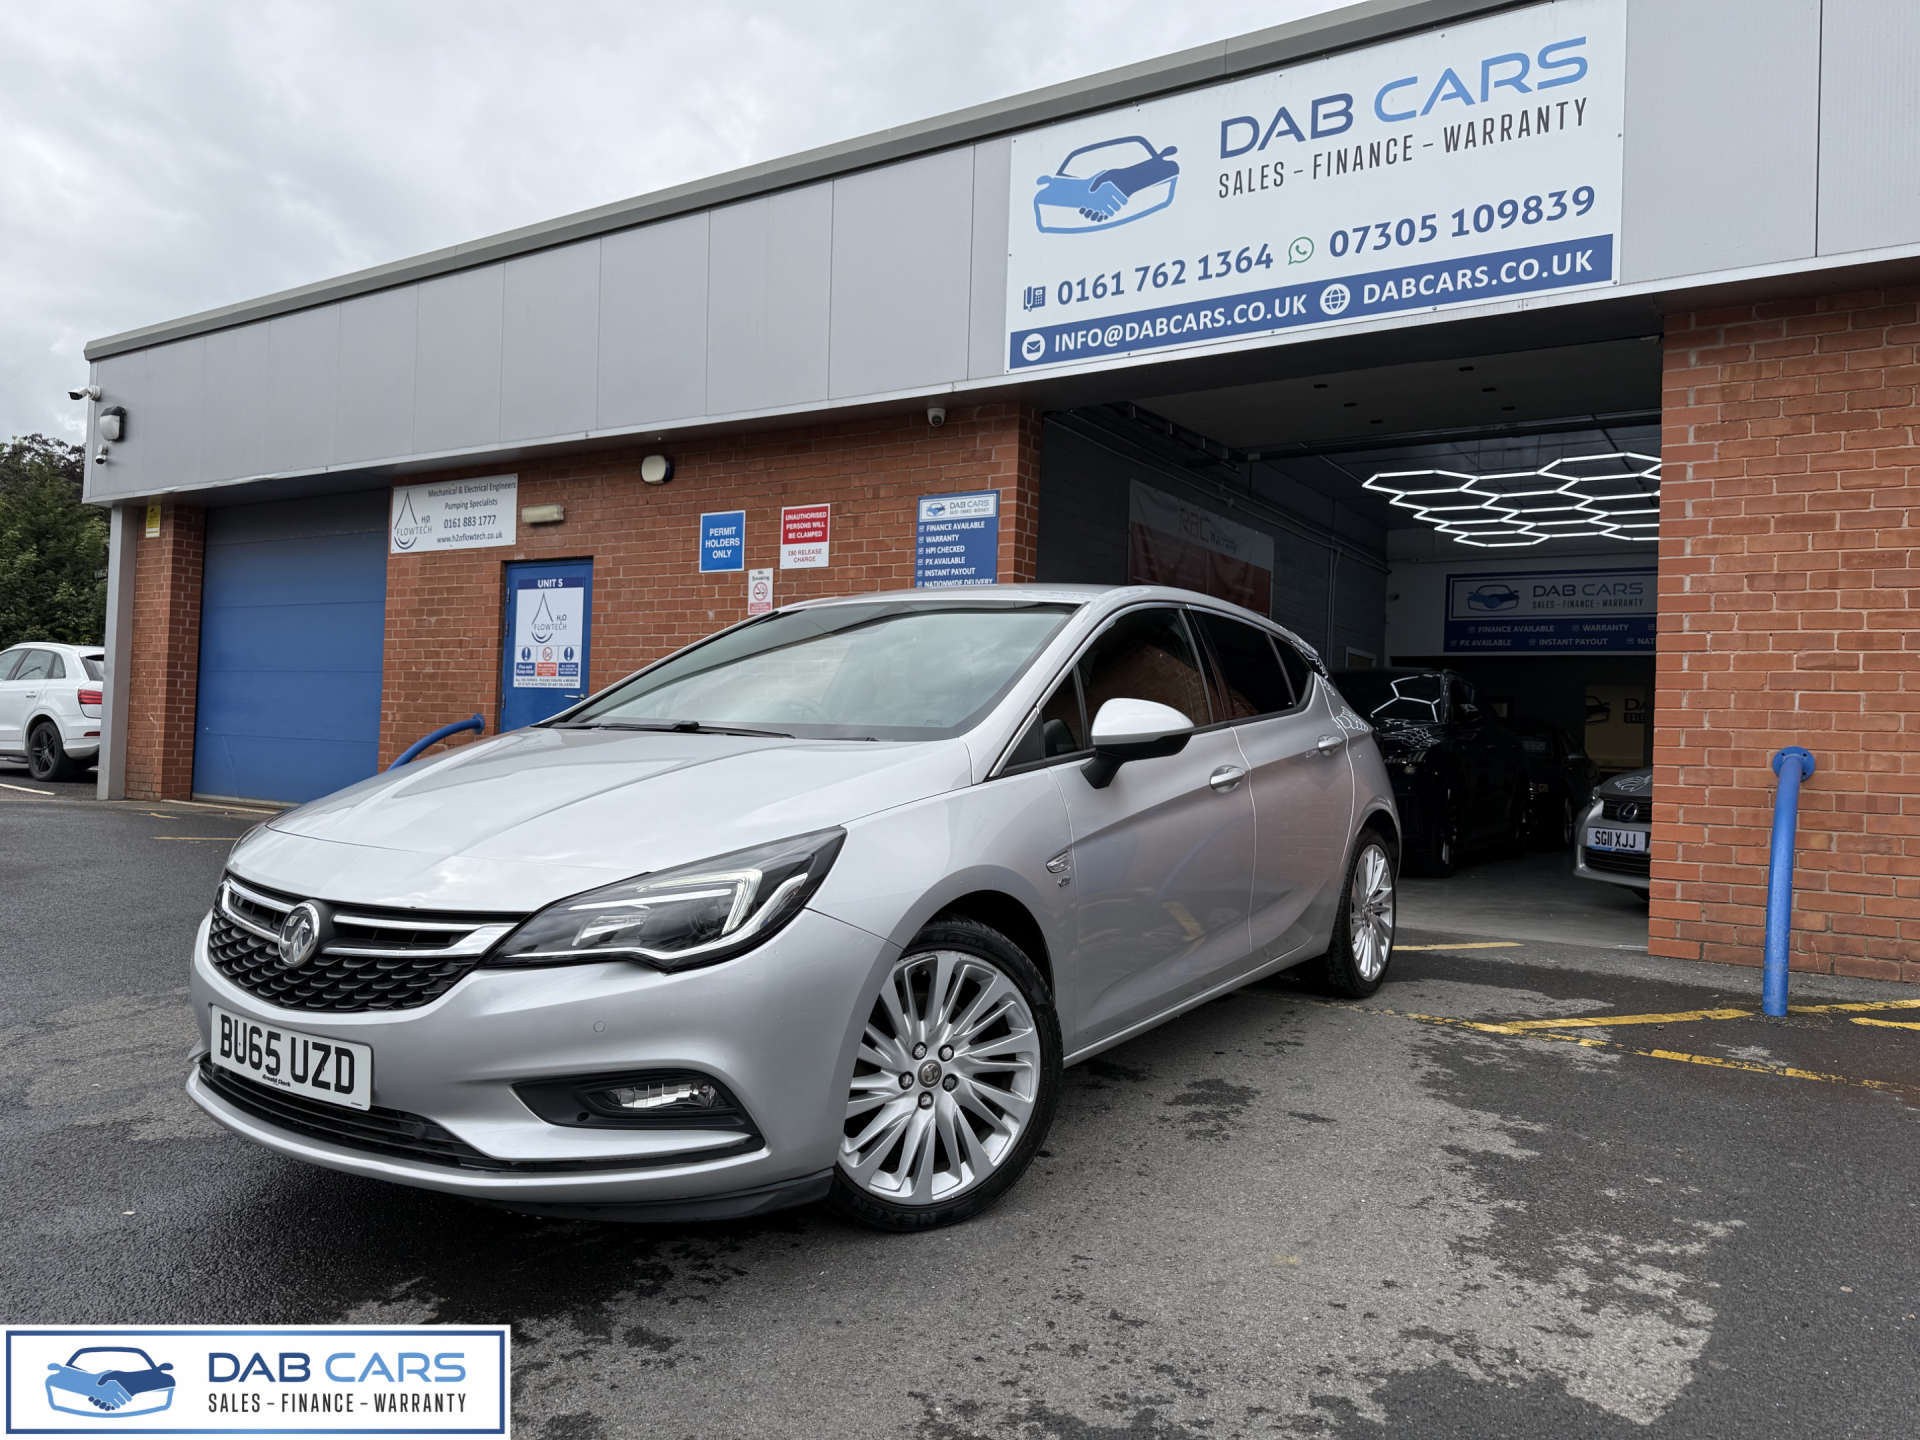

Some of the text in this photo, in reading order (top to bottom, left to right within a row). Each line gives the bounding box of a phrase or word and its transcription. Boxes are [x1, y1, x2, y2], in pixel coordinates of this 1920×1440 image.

[1220, 36, 1588, 159] DAB CARS
[1218, 161, 1285, 198] SALES
[1312, 134, 1414, 180] FINANCE
[1443, 97, 1588, 153] WARRANTY
[1329, 185, 1596, 258] 07305 109839
[1057, 243, 1273, 305] 0161 762 1364
[1363, 250, 1593, 305] DABCARS.CO.UK
[1054, 294, 1307, 353] INFO@DABCARS.CO.UK
[428, 487, 457, 497] Mechanical
[464, 484, 488, 494] Electrical
[489, 481, 516, 493] Engineers
[445, 498, 498, 511] Pumping Specialists
[785, 511, 827, 521] UNAUTHORISED
[444, 515, 497, 529] 0161 883 1777
[786, 522, 811, 530] PERSONS
[926, 521, 985, 532] FINANCE AVAILABLE
[396, 525, 433, 537] FLOWTECH
[709, 526, 736, 536] PERMIT
[797, 530, 822, 538] CLAMPED
[705, 538, 740, 548] HOLDERS
[925, 534, 960, 543] WARRANTY
[712, 550, 732, 559] ONLY
[925, 545, 965, 554] HPI CHECKED
[934, 556, 966, 565] AVAILABLE
[924, 567, 976, 577] INSTANT PAYOUT
[537, 578, 563, 588] UNIT 5
[1533, 582, 1644, 597] DAB CARS
[533, 623, 568, 631] FLOWTECH
[1513, 625, 1554, 633] AVAILABLE
[1583, 624, 1629, 632] WARRANTY
[1576, 638, 1608, 646] PAYOUT
[1595, 830, 1636, 848] SG11 XJJ
[220, 1014, 354, 1094] BU65 UZD
